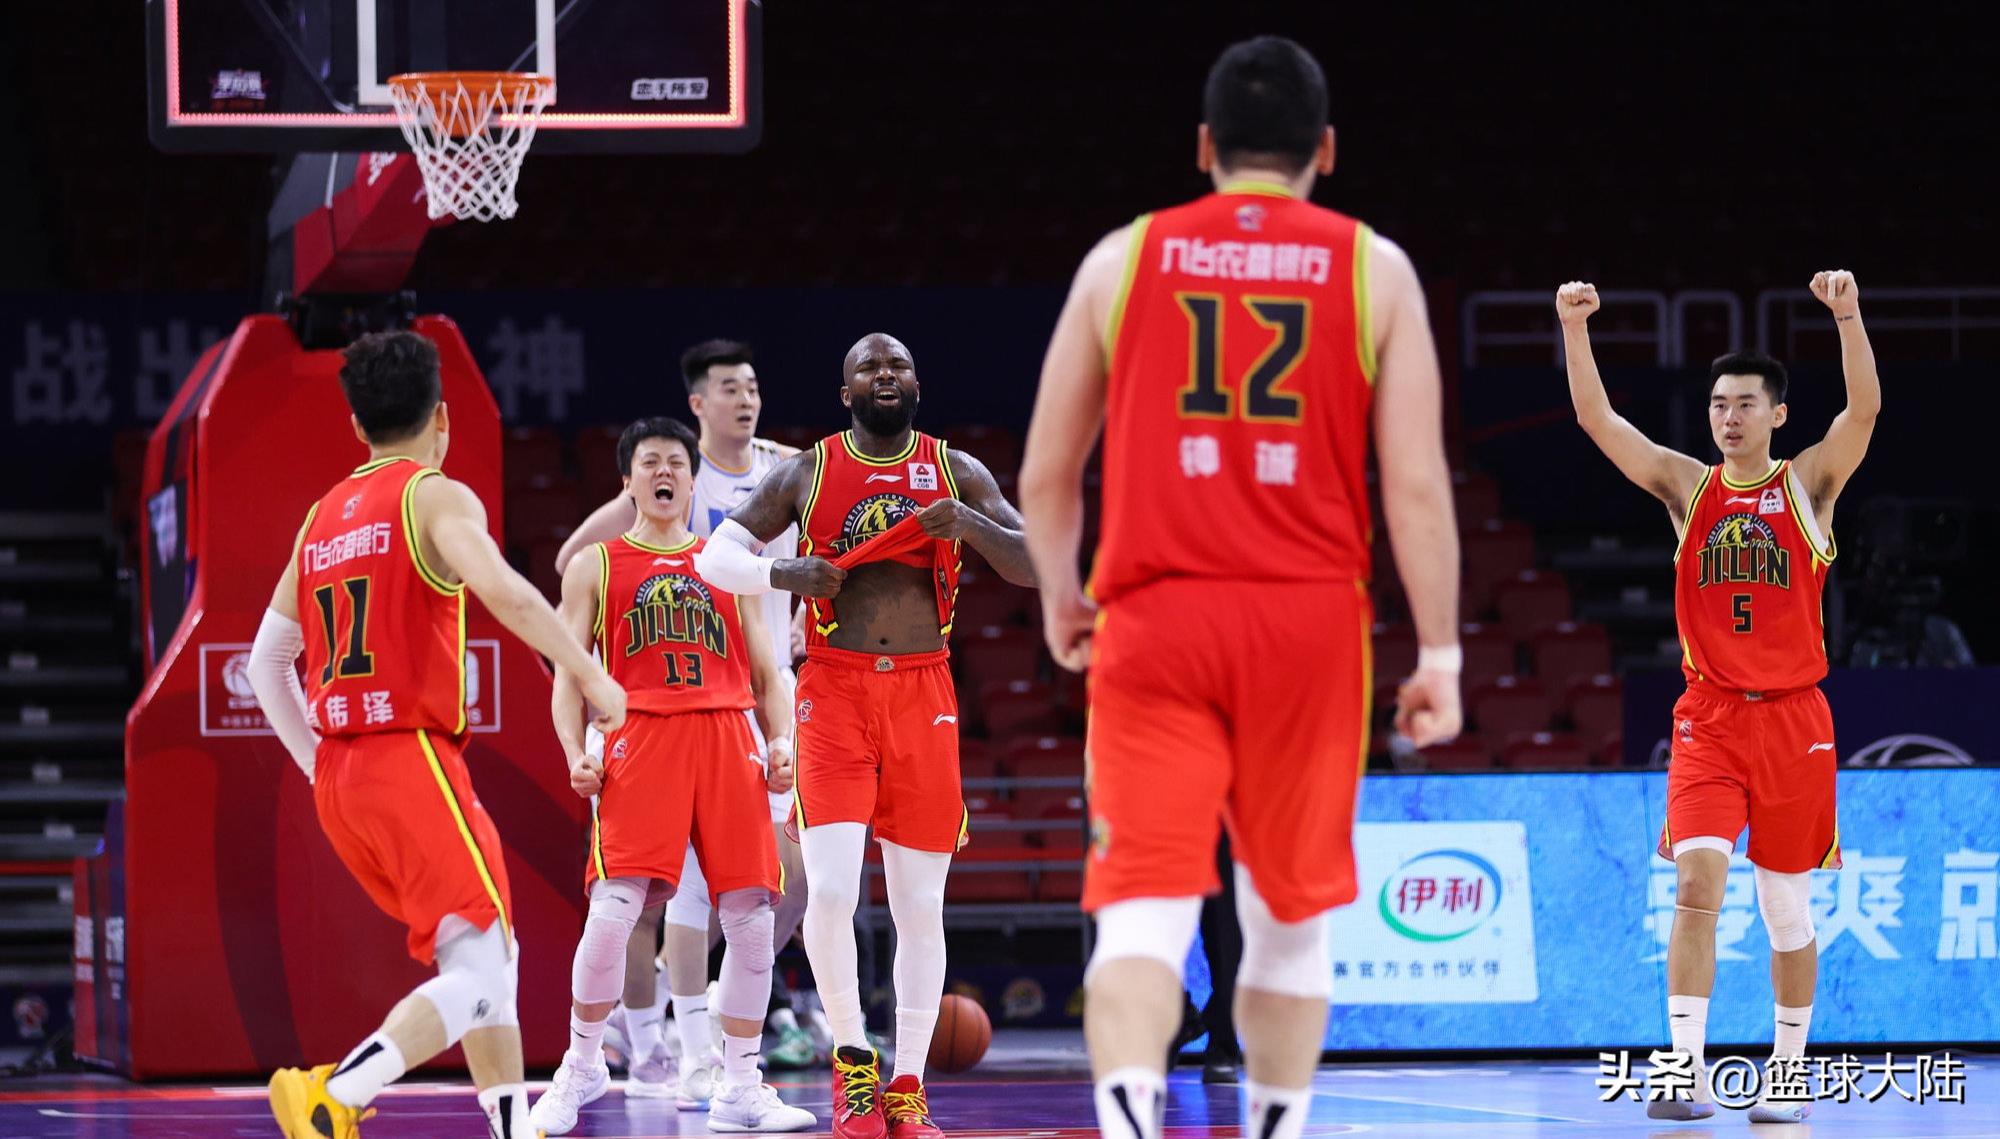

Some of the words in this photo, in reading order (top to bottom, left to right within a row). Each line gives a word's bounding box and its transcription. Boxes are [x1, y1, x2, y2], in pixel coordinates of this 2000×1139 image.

[1174, 291, 1310, 425] 12
[1696, 543, 1790, 590] JILIN
[314, 575, 375, 688] 11
[623, 602, 727, 659] JILIN
[1731, 593, 1753, 634] 5
[662, 651, 705, 687] 13
[1397, 876, 1484, 914] 伊利
